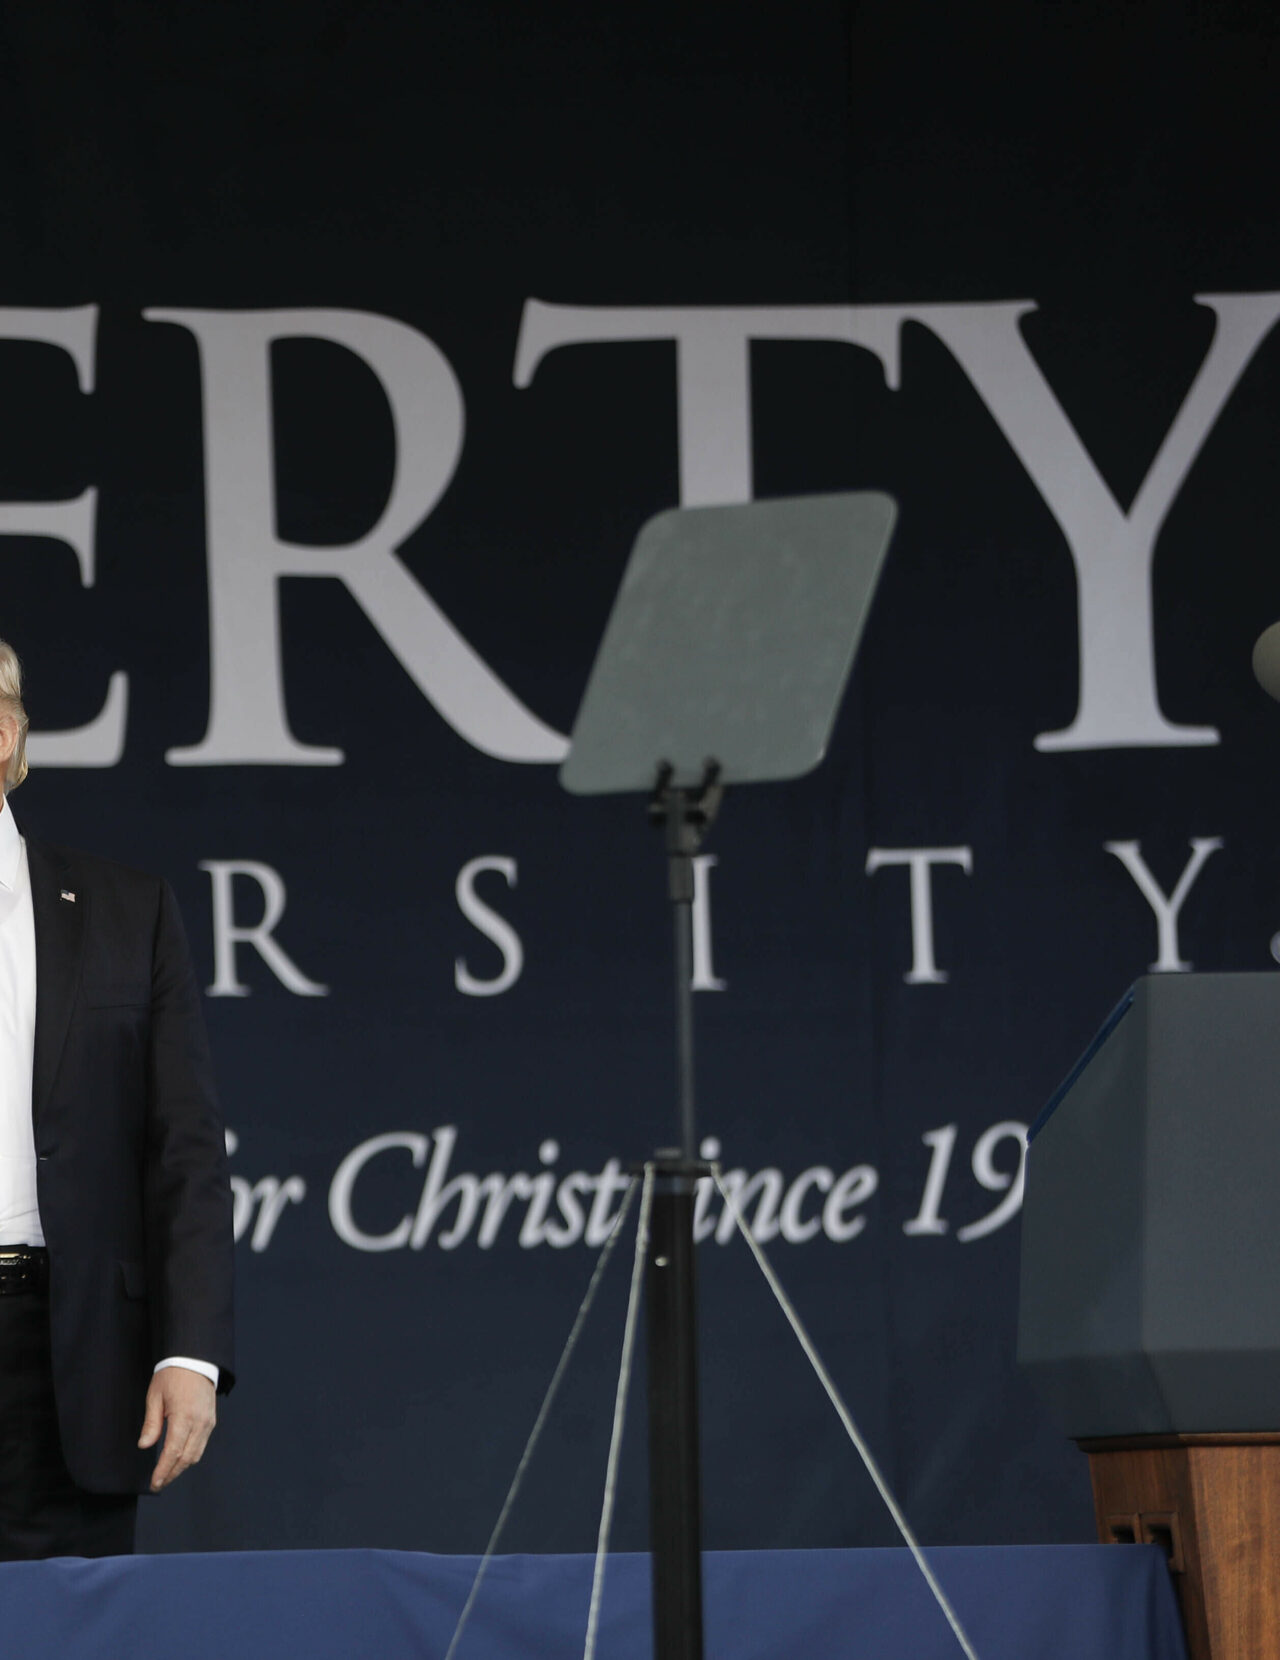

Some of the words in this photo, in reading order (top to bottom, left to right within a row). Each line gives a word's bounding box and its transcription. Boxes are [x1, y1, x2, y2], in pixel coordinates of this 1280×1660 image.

[327, 1124, 634, 1252] Christ
[687, 1136, 879, 1246] ince
[903, 1120, 1028, 1243] 19
